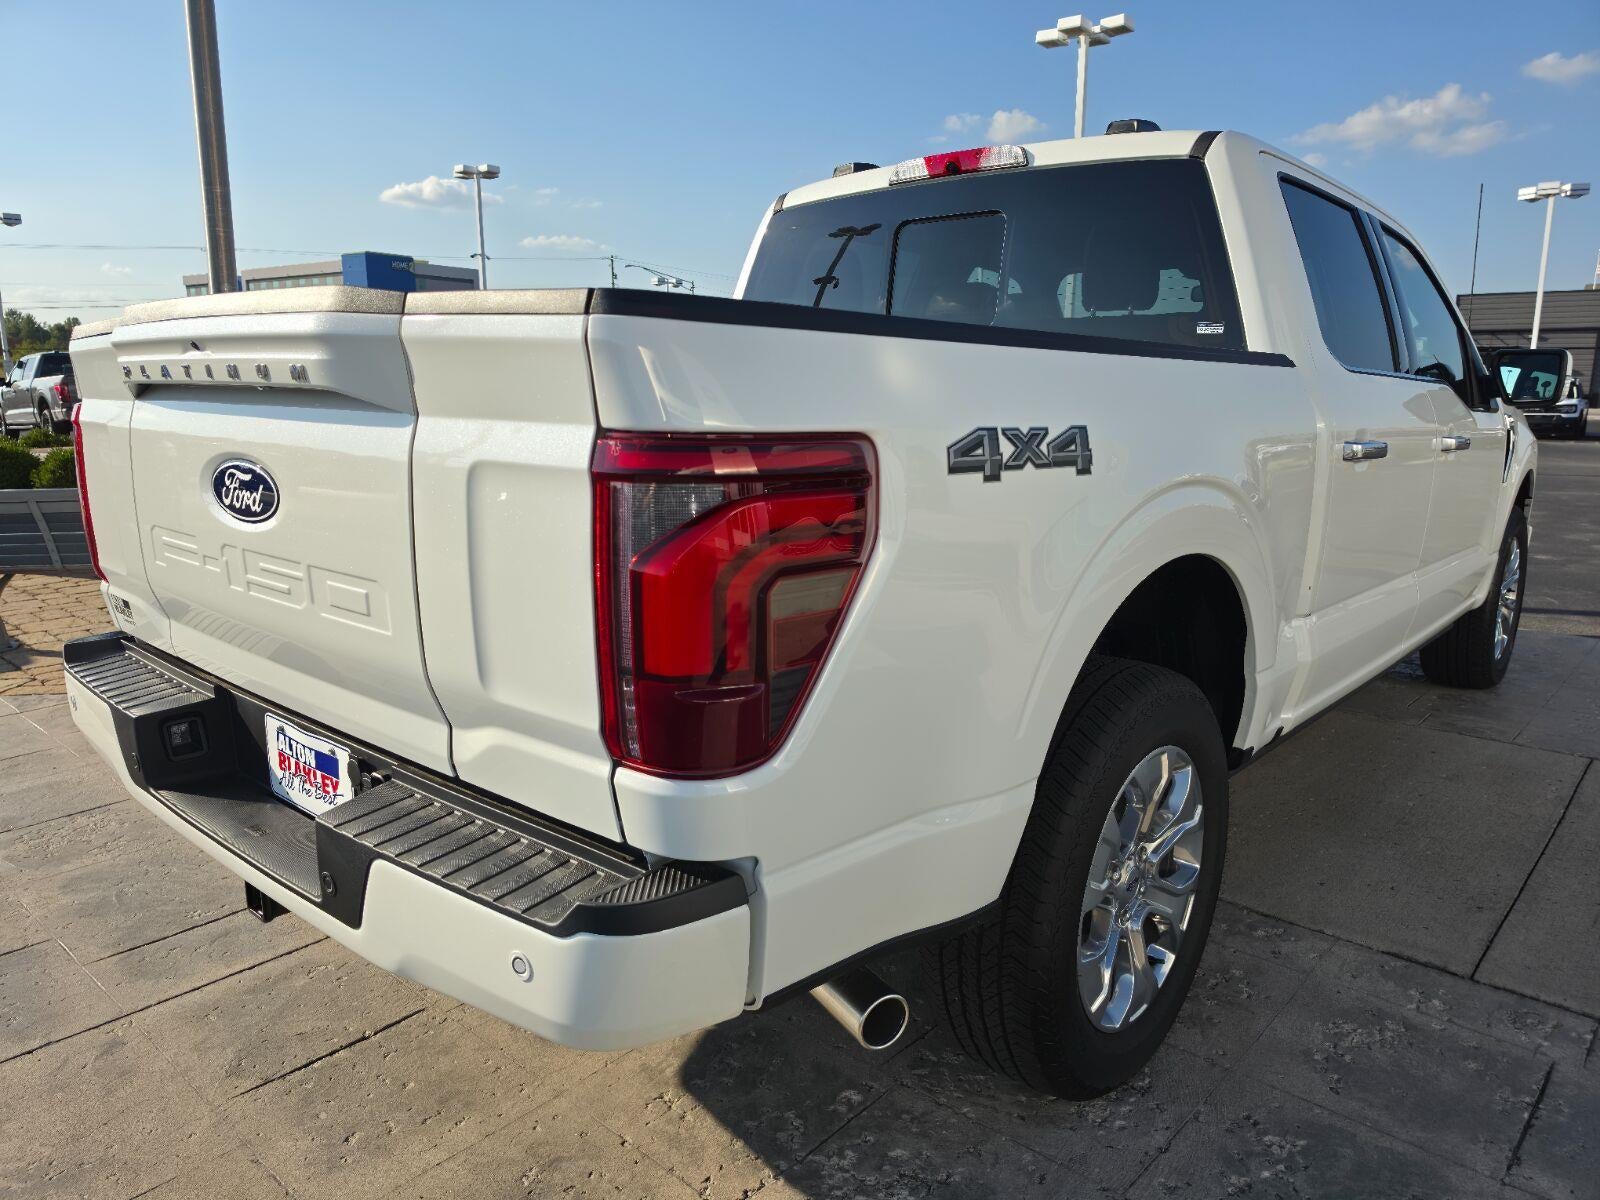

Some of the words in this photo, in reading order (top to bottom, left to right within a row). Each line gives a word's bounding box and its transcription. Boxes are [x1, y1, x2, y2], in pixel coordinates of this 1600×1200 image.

[122, 363, 311, 384] PLATINUM
[222, 468, 264, 512] Ford
[151, 524, 391, 635] F-150
[276, 731, 316, 769] ALTON
[313, 780, 344, 806] Best
